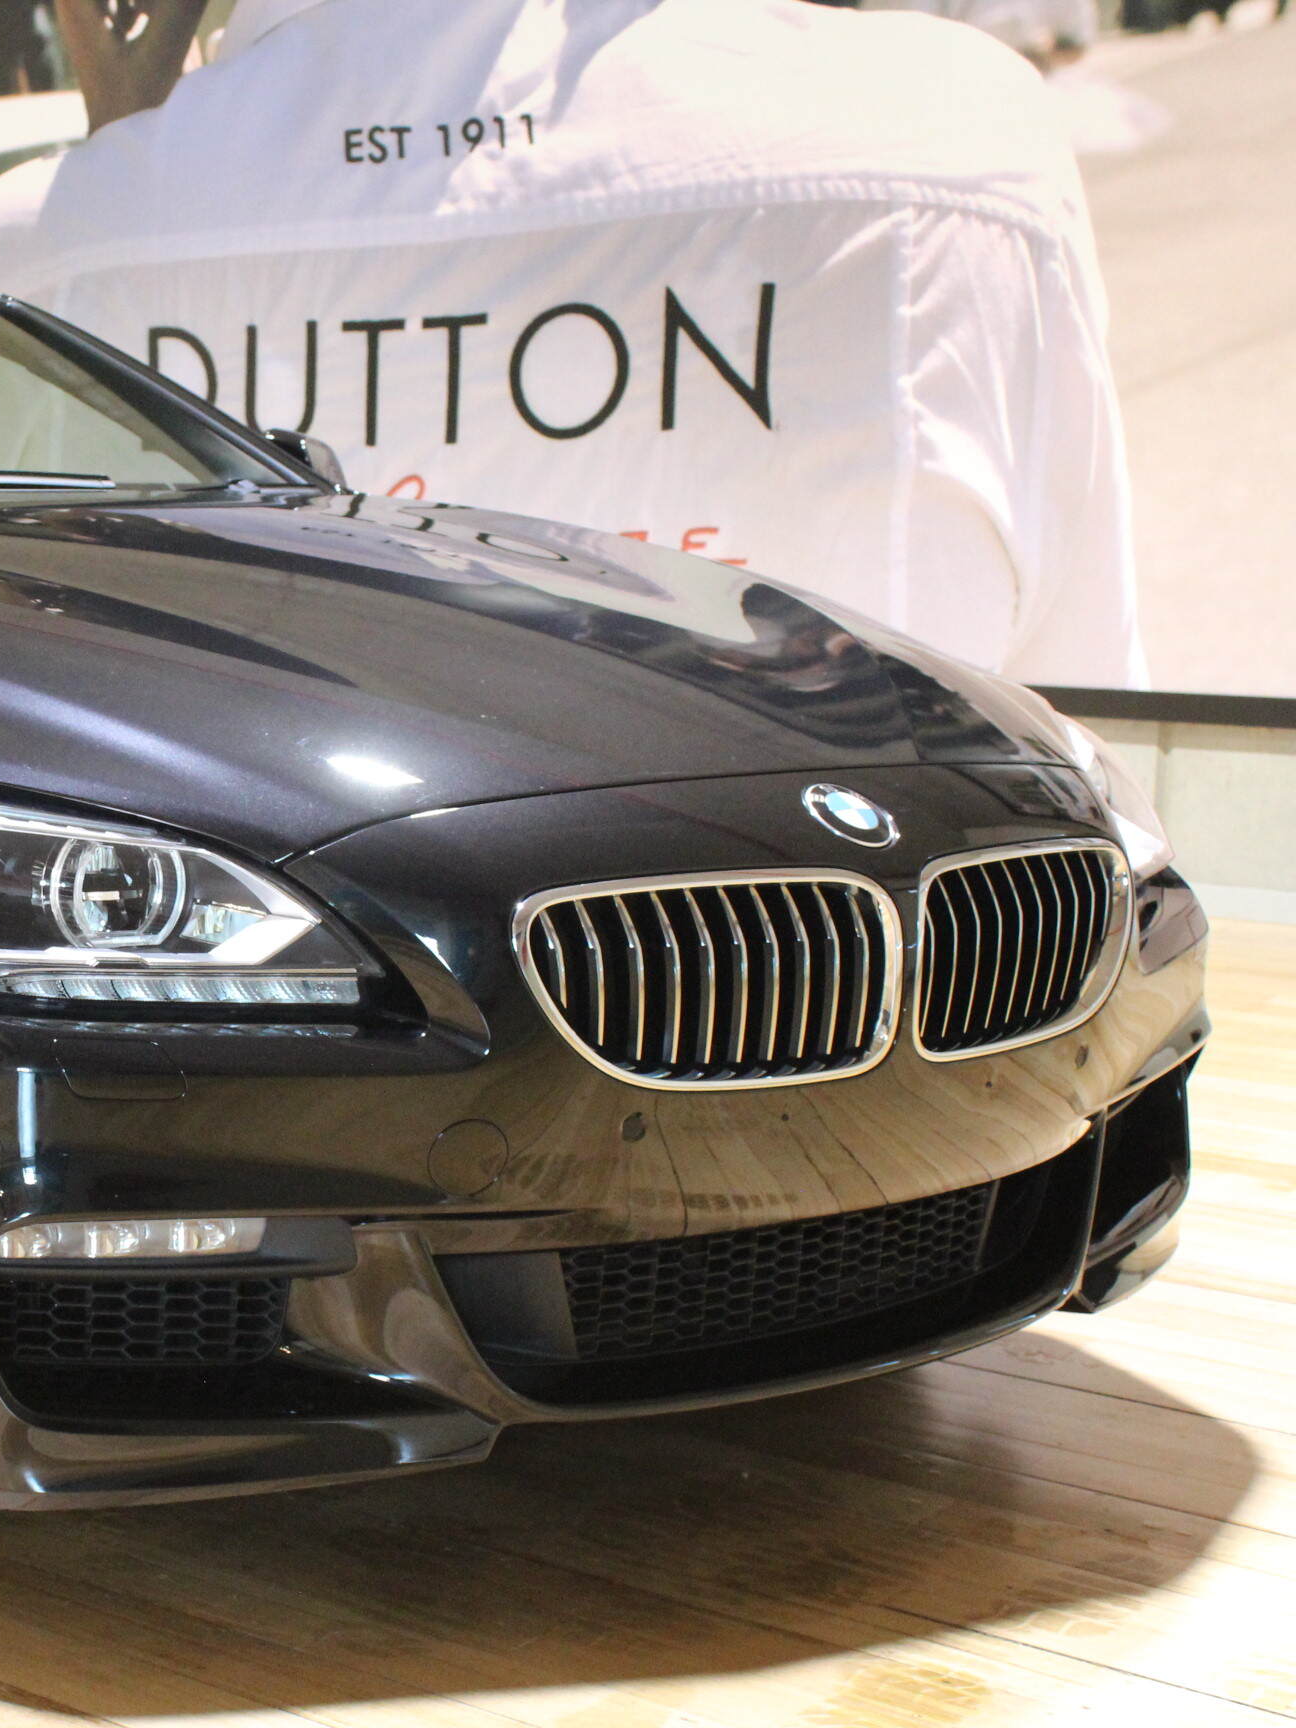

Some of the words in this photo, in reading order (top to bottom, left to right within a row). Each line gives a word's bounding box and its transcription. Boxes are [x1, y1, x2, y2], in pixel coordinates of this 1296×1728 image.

[344, 125, 412, 164] EST
[436, 113, 534, 157] 1911
[148, 282, 776, 447] DUTTON
